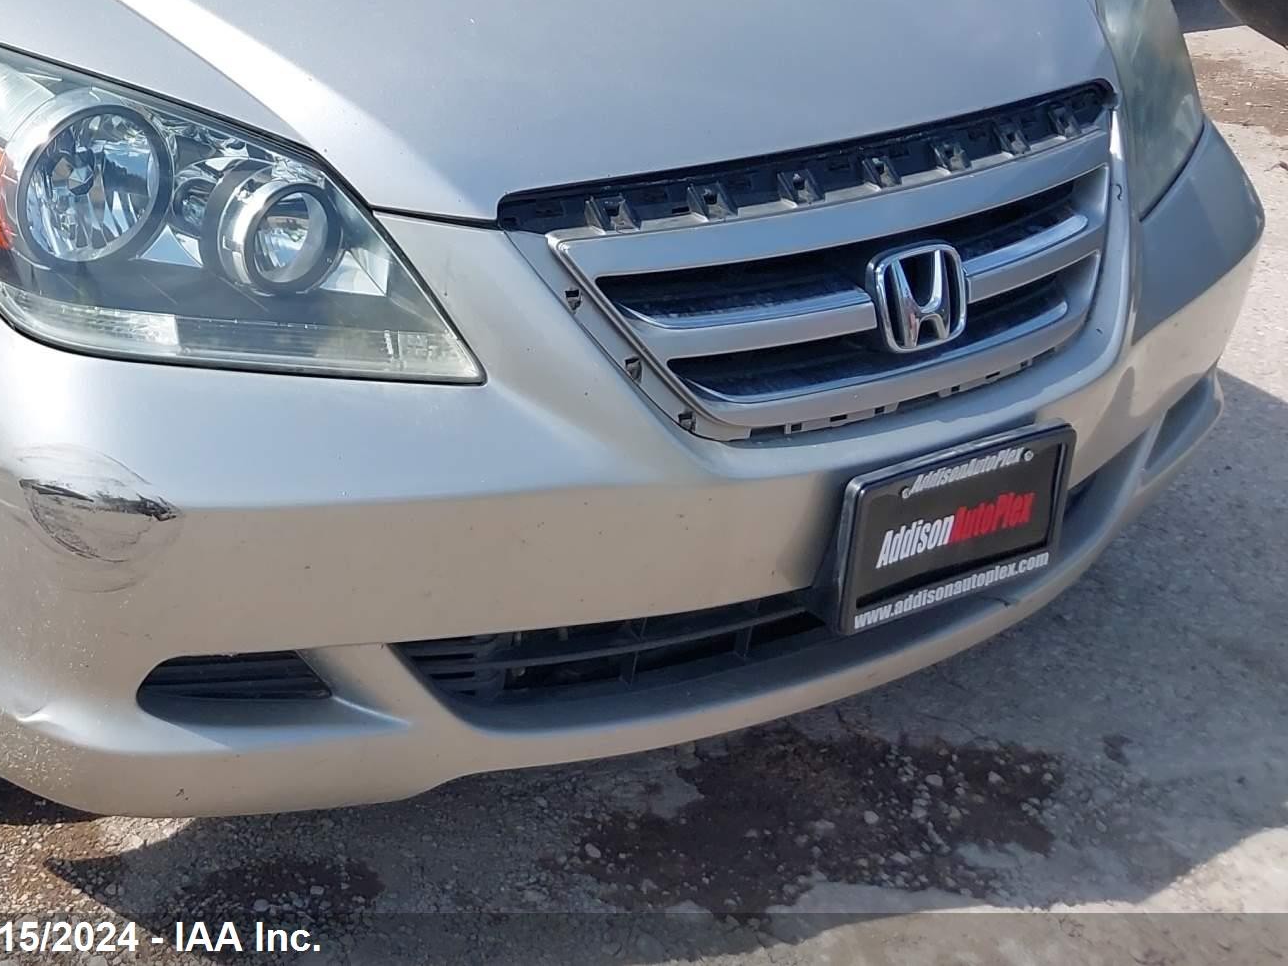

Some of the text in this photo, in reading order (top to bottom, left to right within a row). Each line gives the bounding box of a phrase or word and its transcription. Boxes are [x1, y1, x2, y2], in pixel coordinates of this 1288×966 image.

[909, 446, 1024, 493] AddisonAutoPlex
[875, 492, 1035, 569] AddisonAutoPlex
[853, 551, 1050, 630] www.addisonautoplex.com
